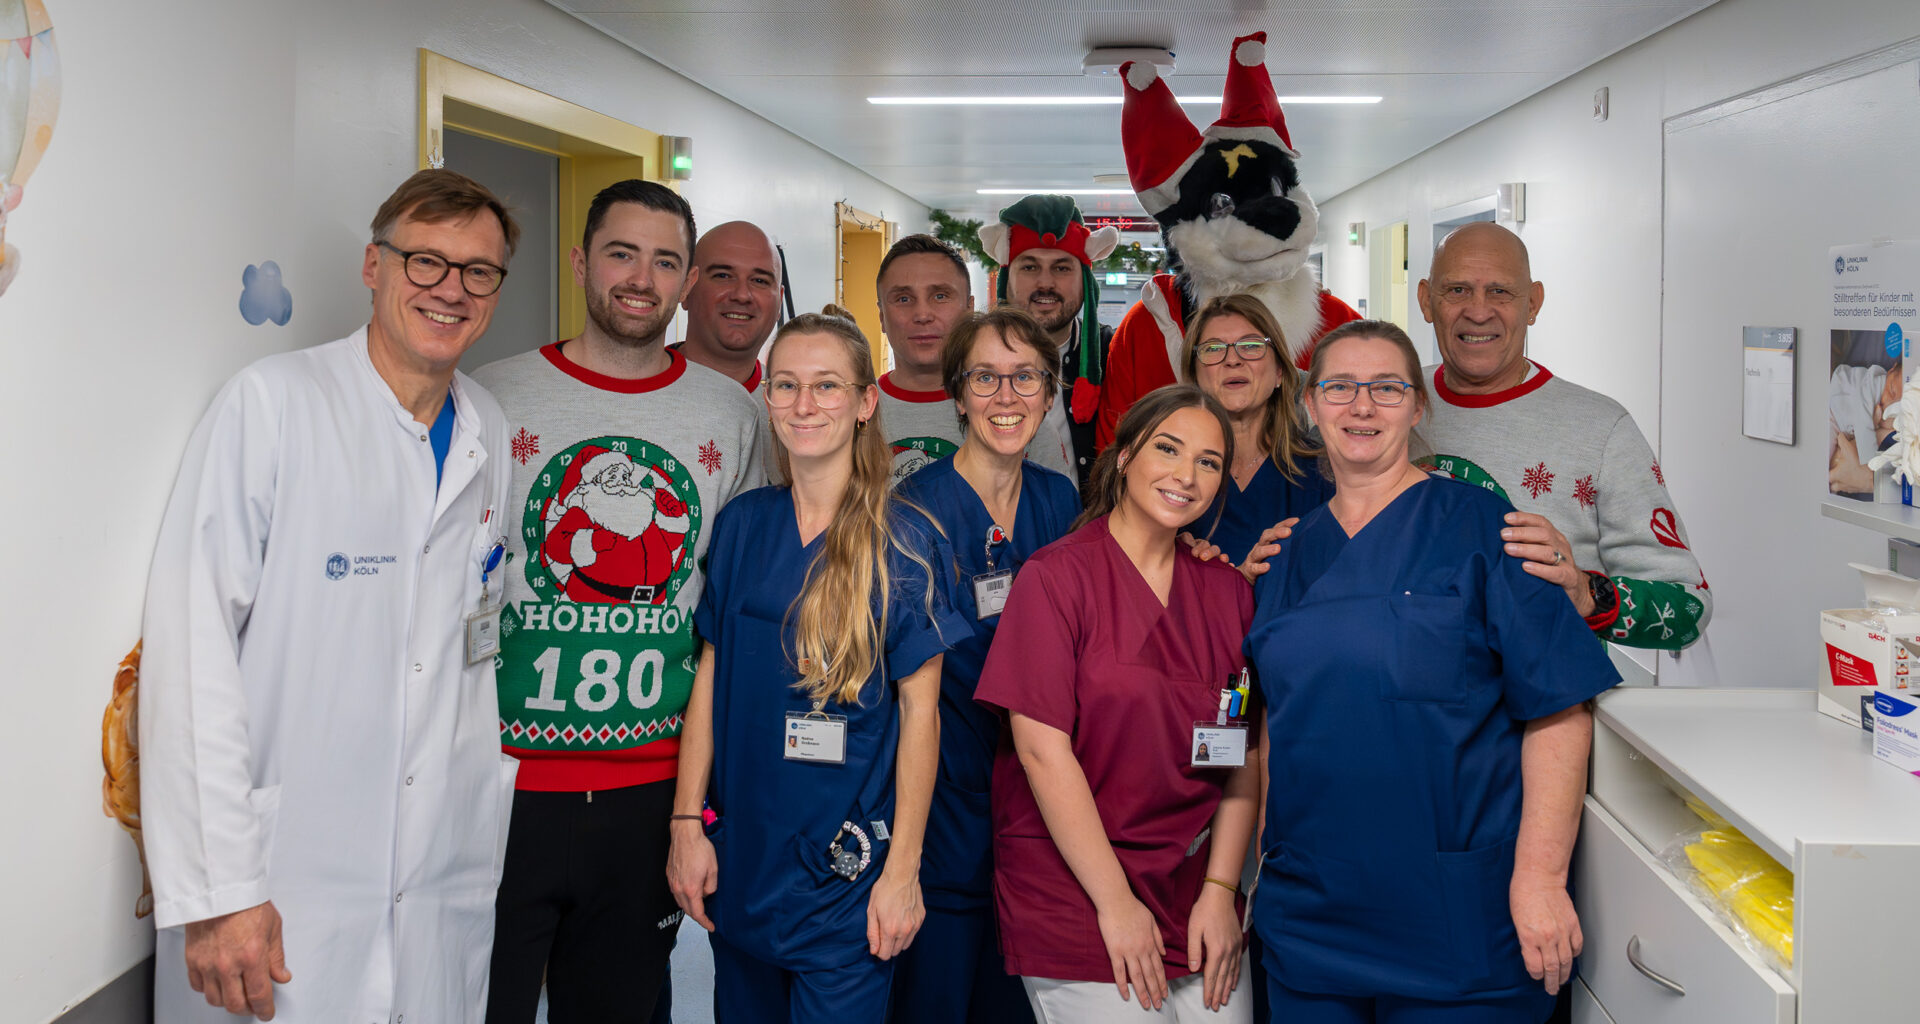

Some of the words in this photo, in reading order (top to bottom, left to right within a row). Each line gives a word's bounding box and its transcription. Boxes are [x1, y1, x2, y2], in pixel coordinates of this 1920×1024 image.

[1868, 292, 1878, 302] für
[1880, 292, 1900, 302] Kinder
[1902, 292, 1914, 302] mit
[1834, 307, 1871, 317] besonderen
[1873, 307, 1917, 317] Bedürfnissen
[612, 441, 627, 452] 20
[912, 441, 925, 450] 20
[935, 443, 940, 452] 1
[641, 447, 646, 458] 1
[559, 454, 573, 466] 12
[661, 458, 676, 472] 18
[1440, 460, 1453, 472] 20
[1463, 467, 1469, 479] 1
[542, 474, 551, 487] 9
[682, 480, 690, 491] 4
[528, 500, 541, 511] 14
[689, 505, 699, 517] 13
[526, 528, 537, 538] 11
[691, 530, 696, 543] 6
[354, 556, 397, 564] UNIKLINIK
[684, 556, 694, 569] 10
[354, 565, 379, 575] KÖLN
[533, 576, 545, 588] 16
[671, 579, 681, 591] 15
[523, 606, 679, 634] HOHOHO
[1868, 632, 1886, 642] DACH
[524, 647, 665, 712] 180
